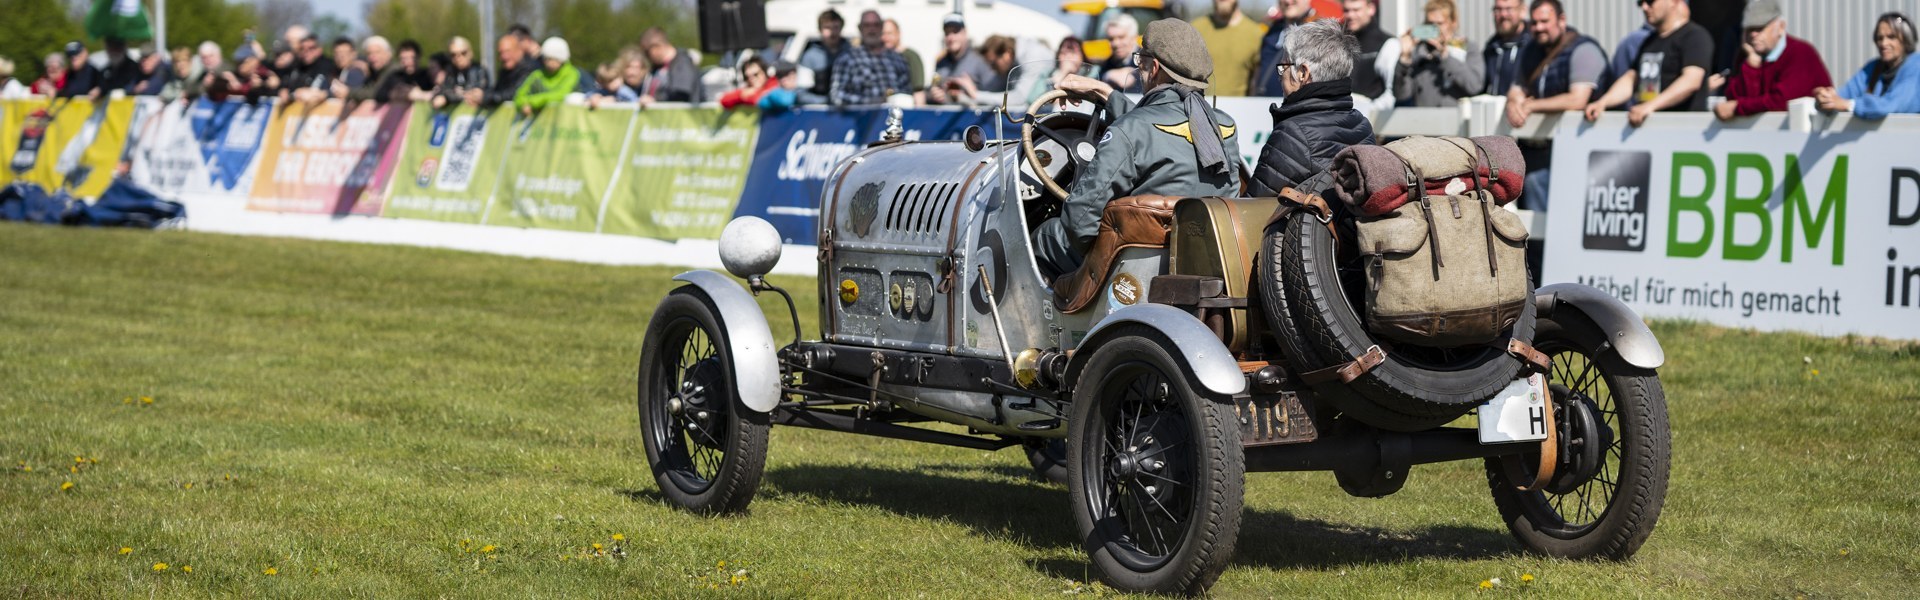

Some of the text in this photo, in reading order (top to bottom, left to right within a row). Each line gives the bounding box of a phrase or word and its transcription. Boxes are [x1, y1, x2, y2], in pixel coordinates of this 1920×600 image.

[1587, 178, 1639, 211] inter
[1666, 152, 1848, 266] BBM
[1585, 204, 1645, 247] living
[1646, 276, 1676, 304] für
[1682, 282, 1734, 309] mich
[1741, 287, 1842, 317] gemacht
[1529, 406, 1545, 435] H
